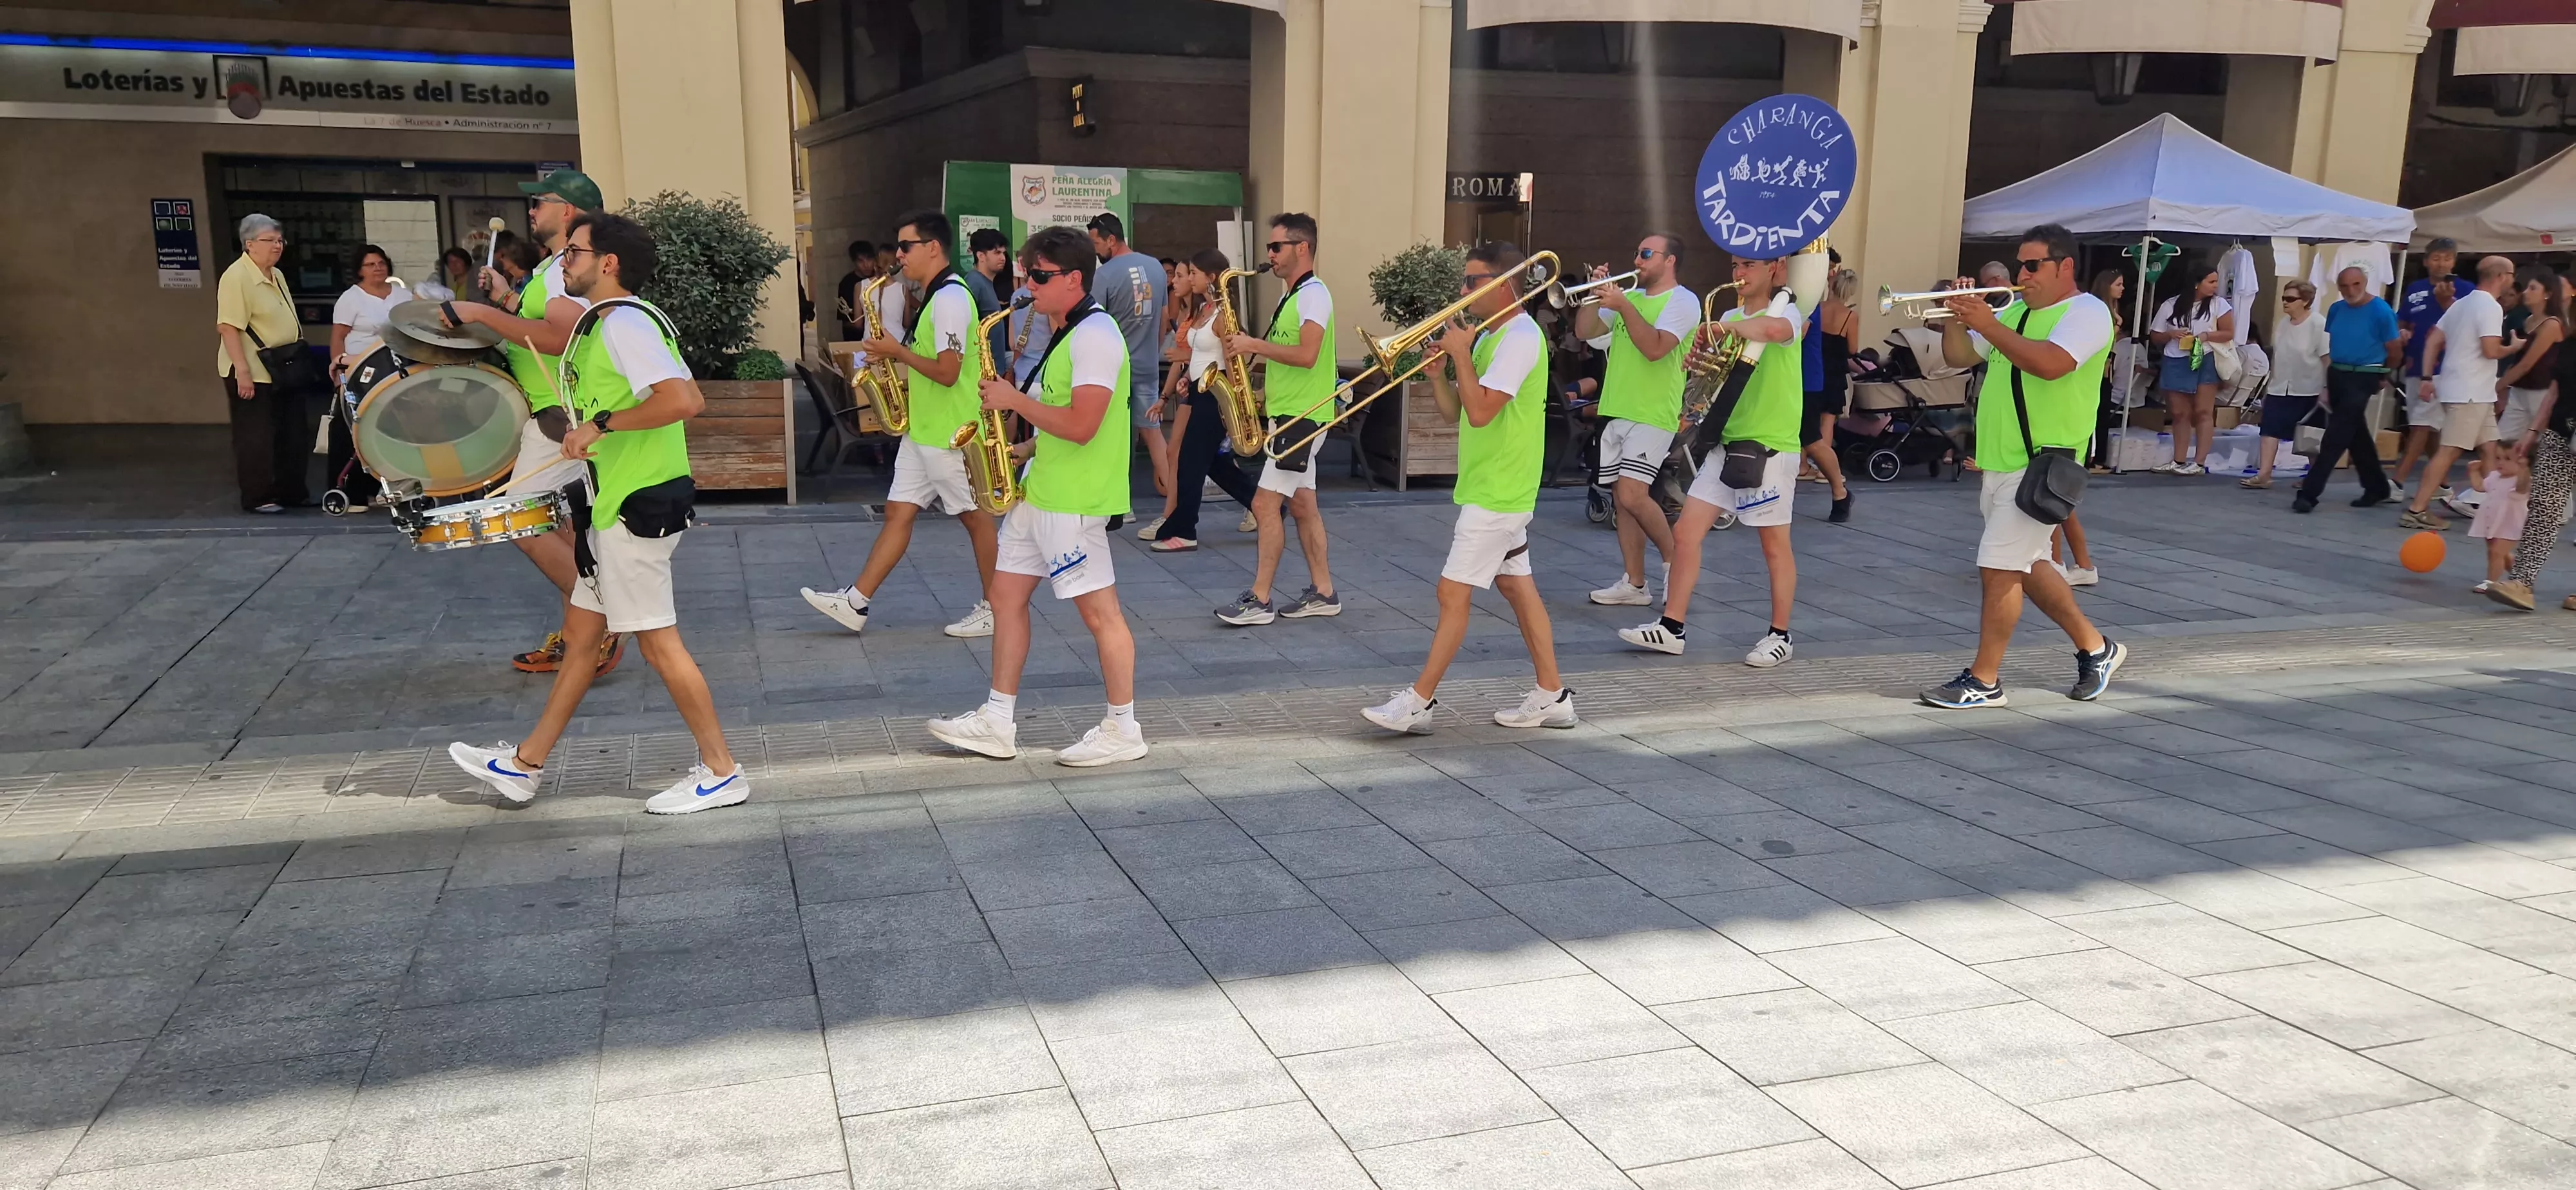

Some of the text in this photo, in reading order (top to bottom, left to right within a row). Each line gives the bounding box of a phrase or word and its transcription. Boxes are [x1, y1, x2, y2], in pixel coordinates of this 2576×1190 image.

[63, 68, 208, 99] Loterías y
[278, 75, 551, 106] Apuestas del Estado
[389, 117, 401, 126] de
[404, 117, 442, 127] Huesca
[1727, 103, 1842, 149] CHARANGA
[1052, 175, 1112, 185] PEÑA ALEGRÍA
[1452, 177, 1524, 198] ROMA
[1052, 187, 1112, 197] LAURENTINA
[1052, 214, 1093, 223] SOCIO PEÑIS
